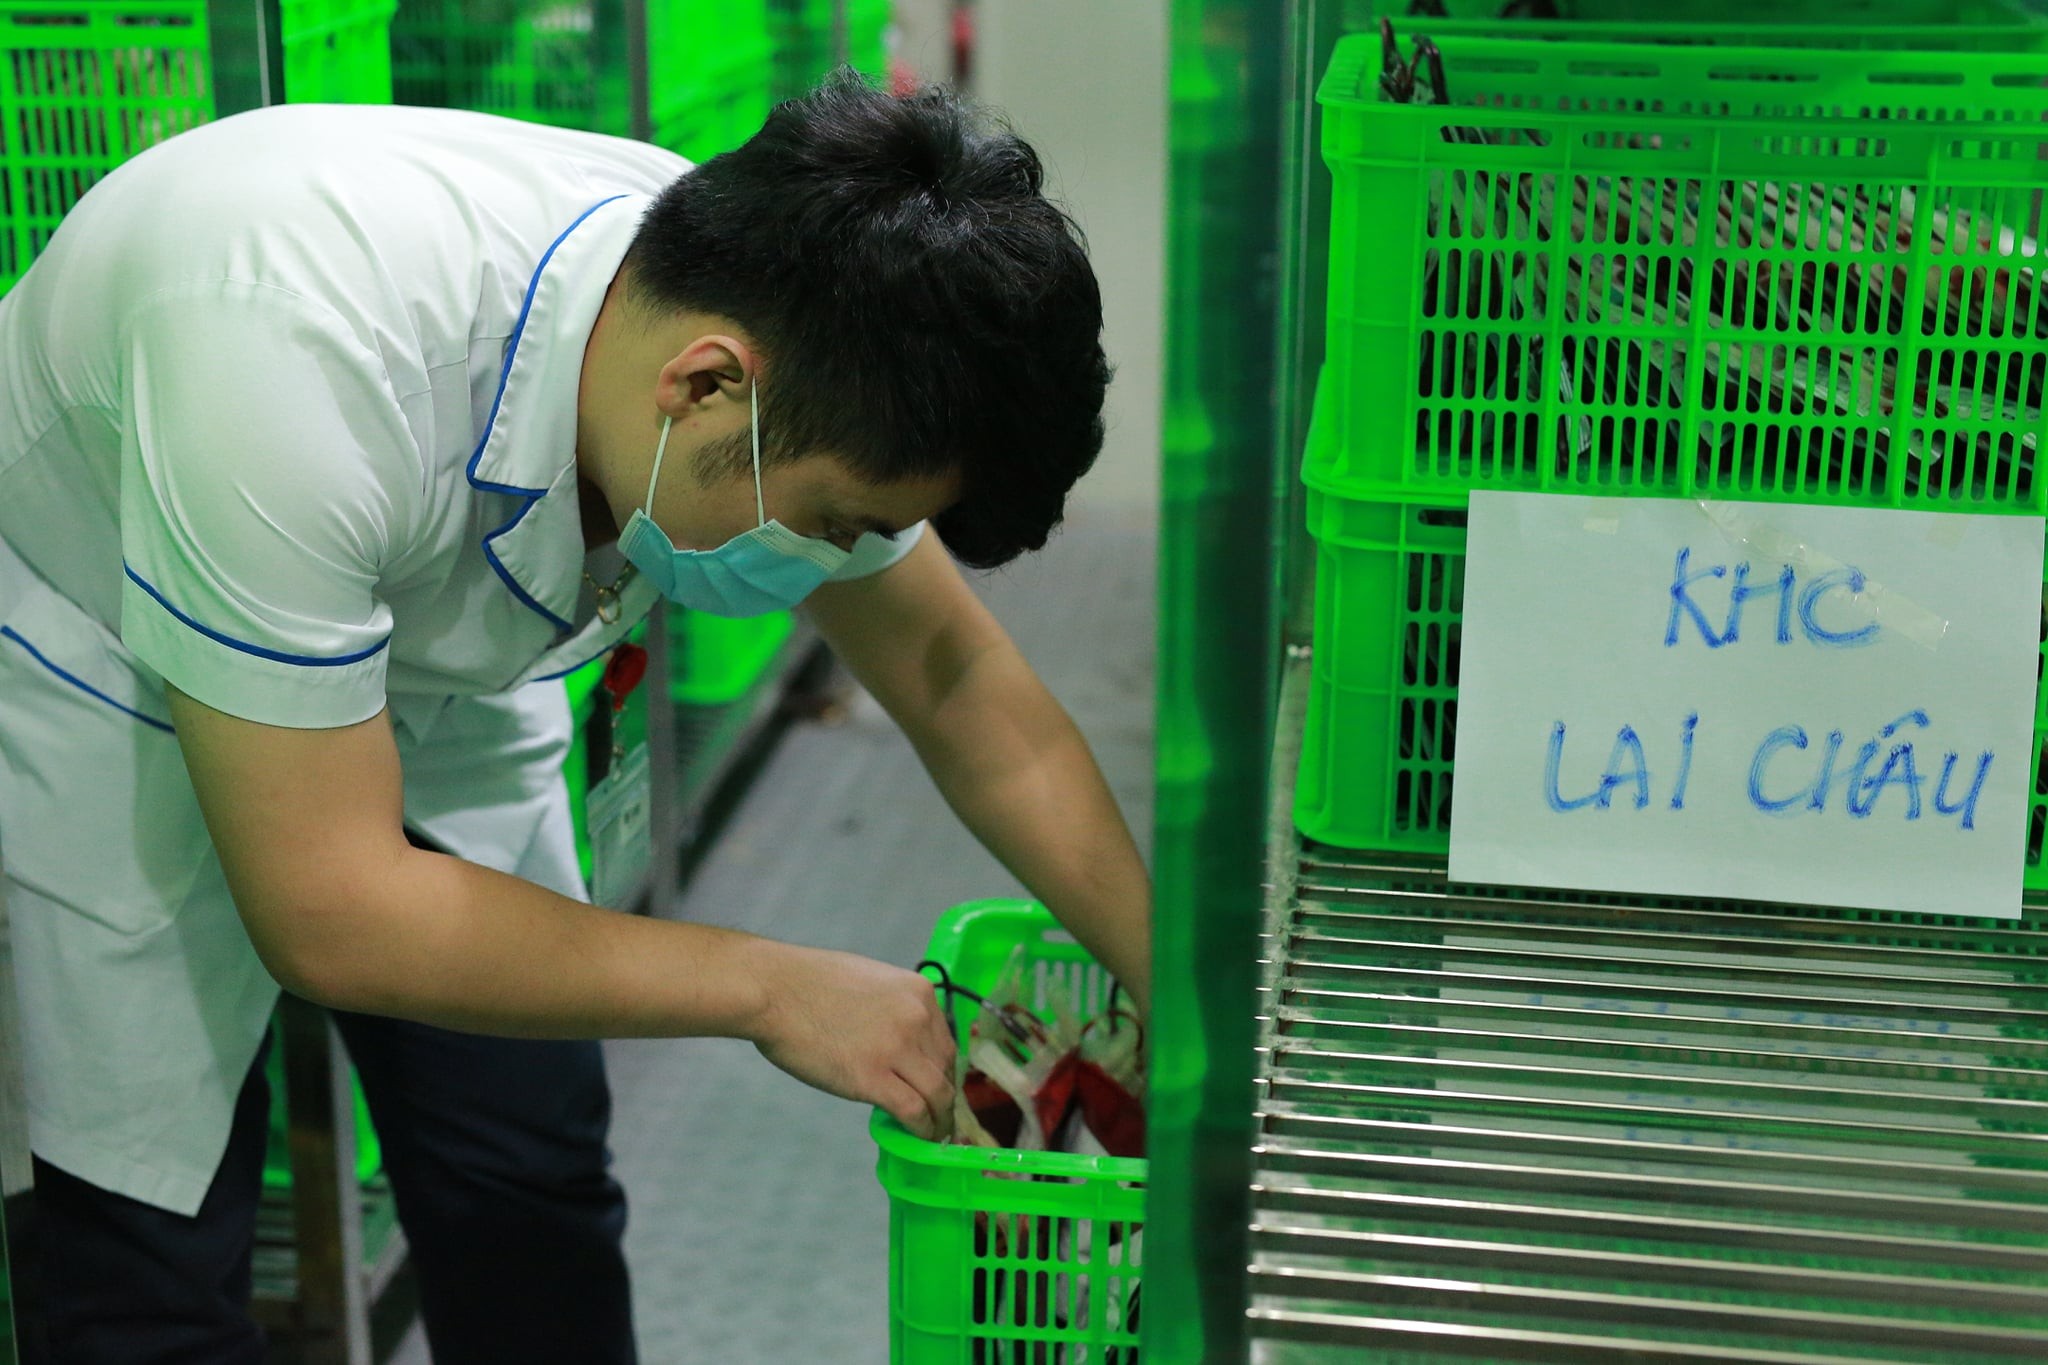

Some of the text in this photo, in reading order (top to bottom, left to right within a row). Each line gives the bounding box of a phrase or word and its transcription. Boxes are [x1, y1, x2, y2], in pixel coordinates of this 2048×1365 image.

[1664, 546, 1882, 649] KHC
[1545, 708, 1995, 831] LAI CHÂU
